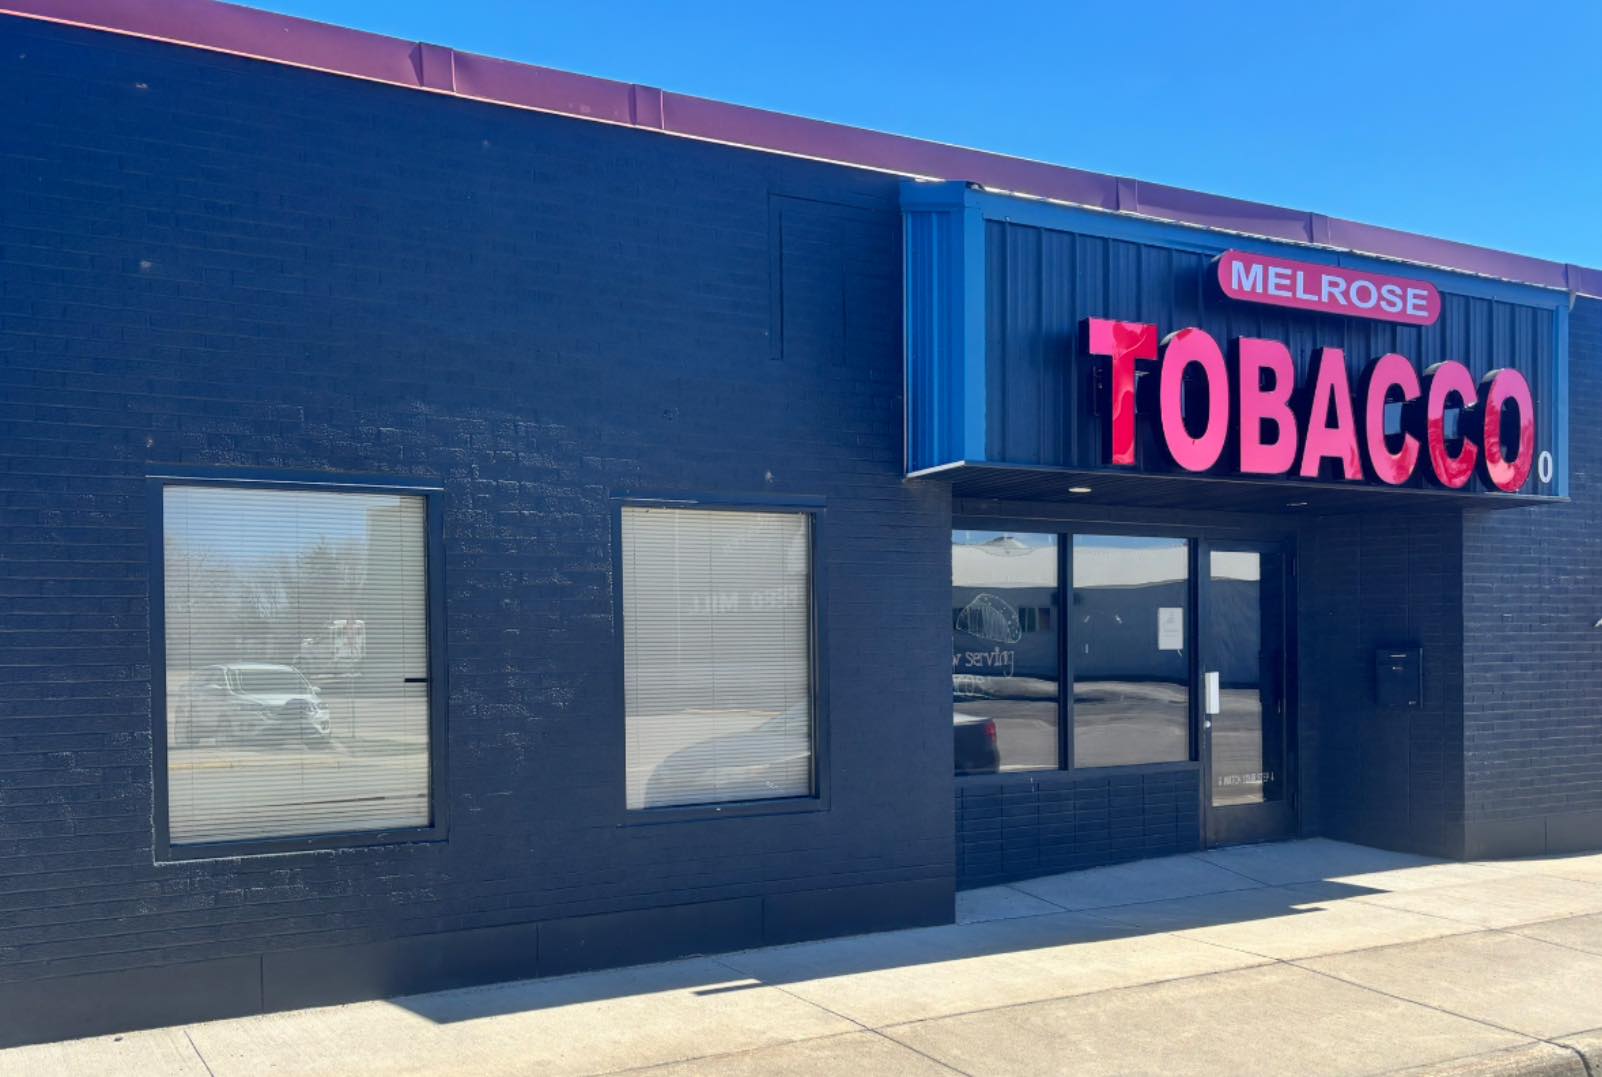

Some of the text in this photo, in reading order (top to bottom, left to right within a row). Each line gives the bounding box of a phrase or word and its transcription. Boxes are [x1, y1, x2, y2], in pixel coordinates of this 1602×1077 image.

[1231, 260, 1429, 317] MELROSE
[1088, 317, 1535, 493] TOBACCO
[965, 646, 1015, 678] serving
